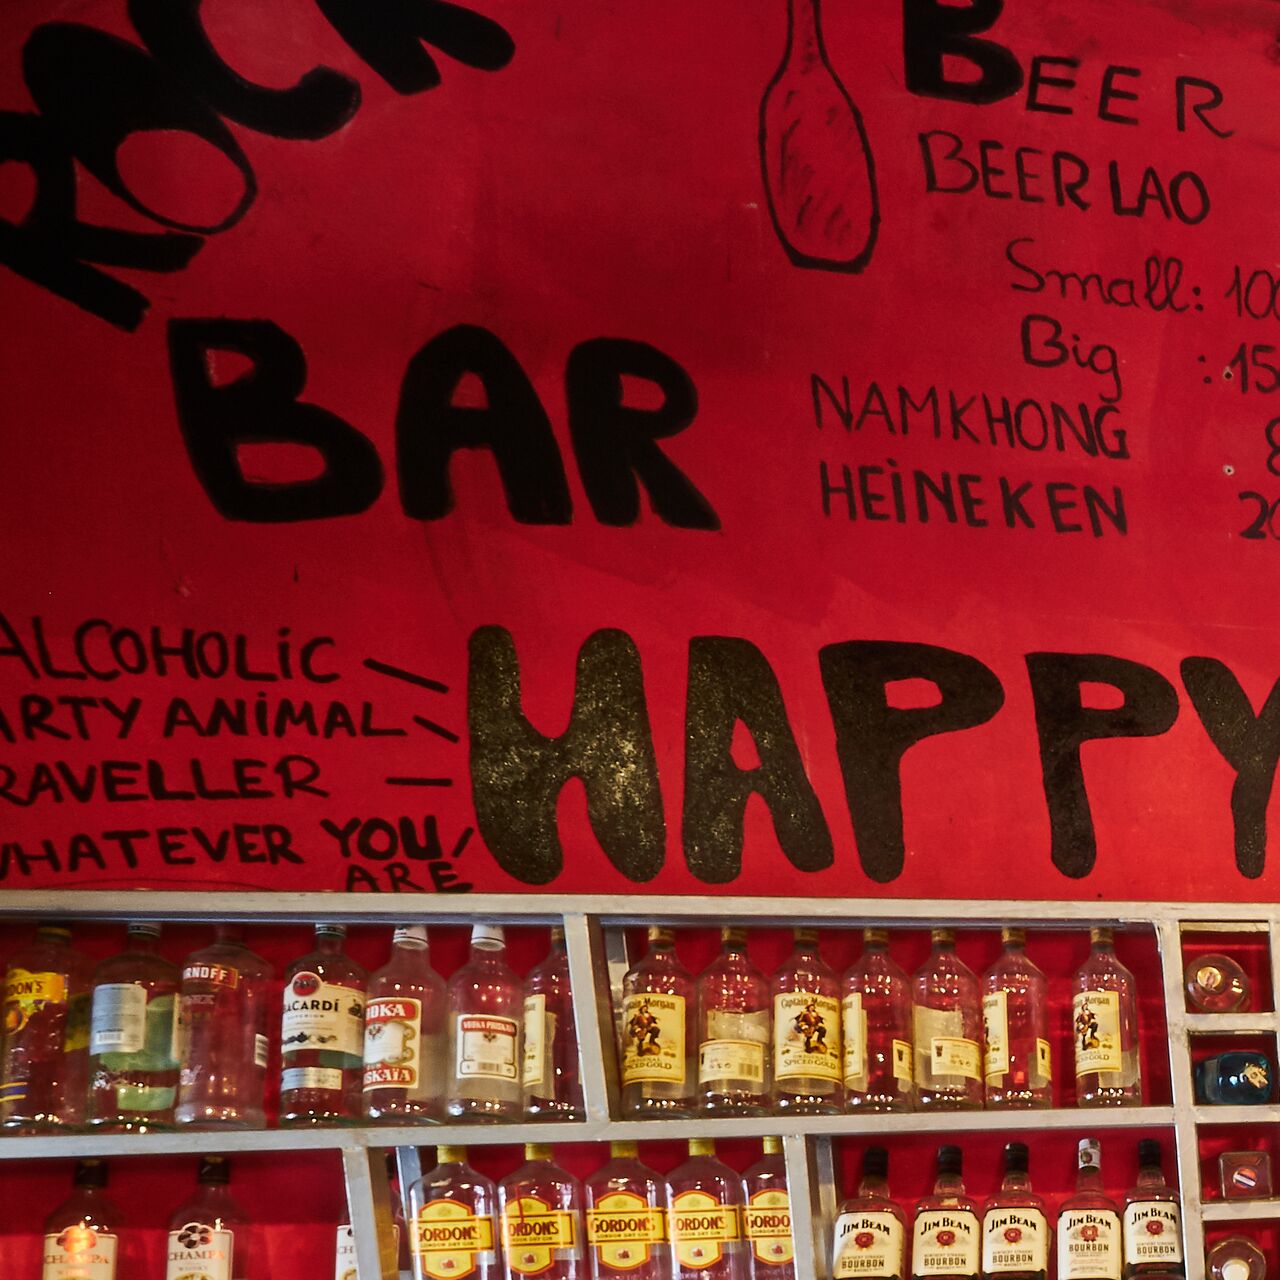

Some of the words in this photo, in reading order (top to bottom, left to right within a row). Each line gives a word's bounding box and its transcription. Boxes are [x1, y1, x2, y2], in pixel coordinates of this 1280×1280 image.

[902, 0, 1234, 138] BEER
[1021, 314, 1122, 400] Big
[167, 317, 721, 532] BAR
[811, 372, 1129, 459] NAMKHONG
[319, 815, 443, 862] YOU
[345, 861, 474, 894] ARE
[920, 1218, 941, 1235] JIM
[941, 1216, 971, 1235] BEAM
[988, 1215, 1008, 1232] JIM
[1008, 1214, 1038, 1232] BEAM
[1066, 1214, 1086, 1231] JIM
[1086, 1213, 1112, 1231] BEAM
[1131, 1209, 1150, 1226] JIM
[1150, 1206, 1177, 1225] BEAM
[840, 1221, 860, 1238] JIM
[861, 1217, 891, 1236] BEAM
[1068, 1243, 1109, 1254] BOURBON
[1136, 1244, 1176, 1255] BOURBON
[841, 1259, 885, 1270] BOURBON
[923, 1257, 967, 1267] BOURBON
[991, 1253, 1035, 1264] BOURBON
